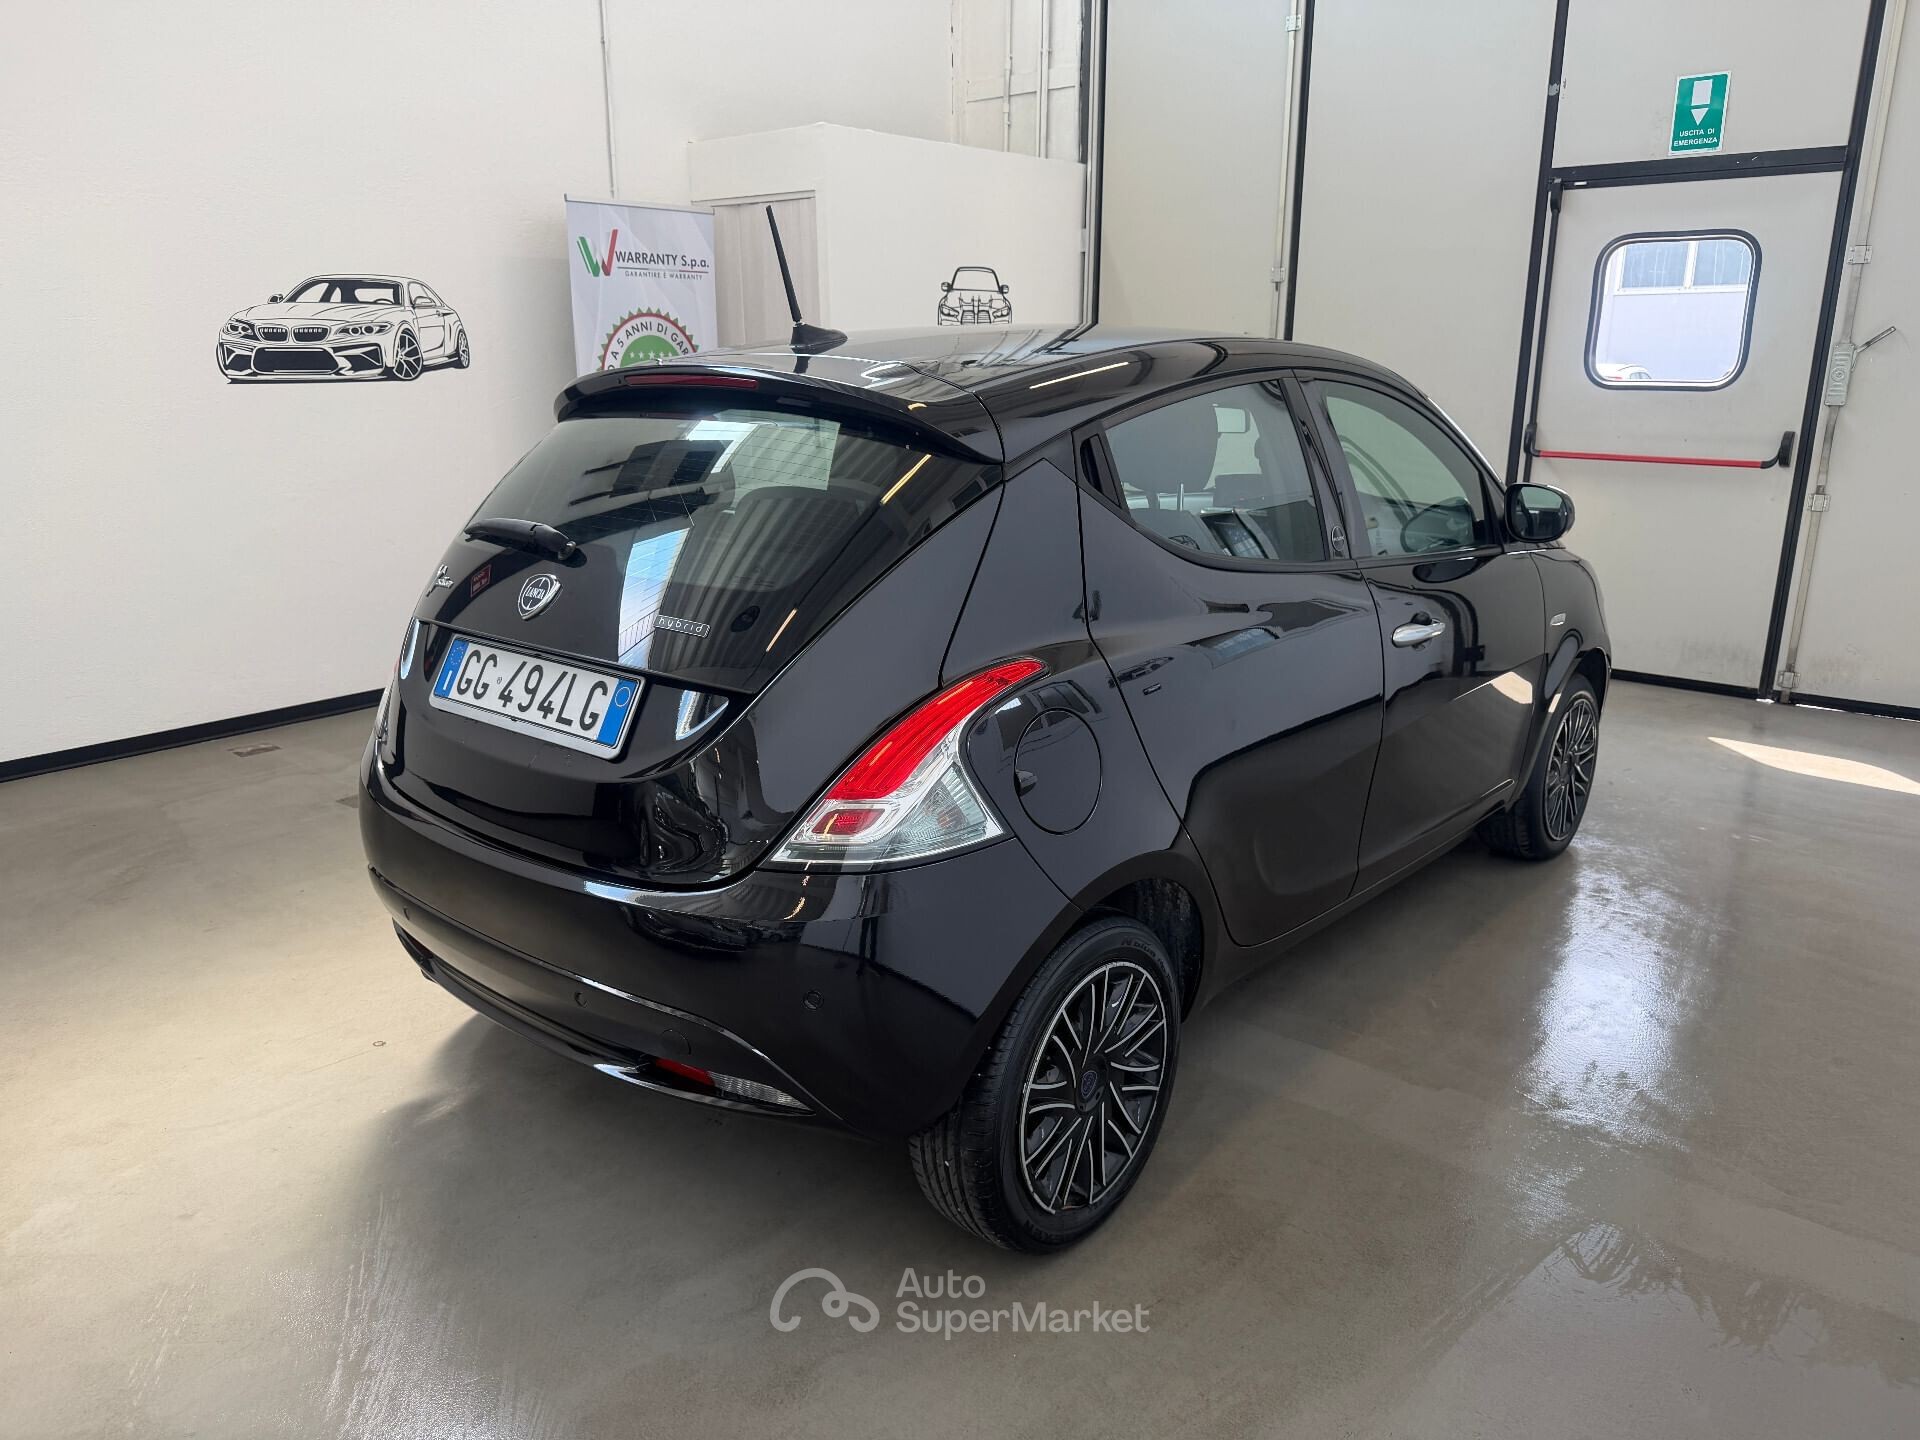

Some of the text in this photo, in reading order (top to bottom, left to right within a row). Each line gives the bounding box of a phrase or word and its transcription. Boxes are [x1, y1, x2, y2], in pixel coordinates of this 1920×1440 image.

[1674, 137, 1718, 146] EMERGENZA
[615, 250, 710, 270] WARRANTY S.p.a.
[625, 270, 660, 279] GARANTIRE
[669, 272, 703, 281] WARRANTY
[611, 351, 619, 361] A
[617, 338, 624, 348] 5
[625, 321, 653, 340] ANNI
[657, 322, 668, 335] DI
[525, 586, 546, 600] LANCIA
[658, 617, 706, 633] hybrid
